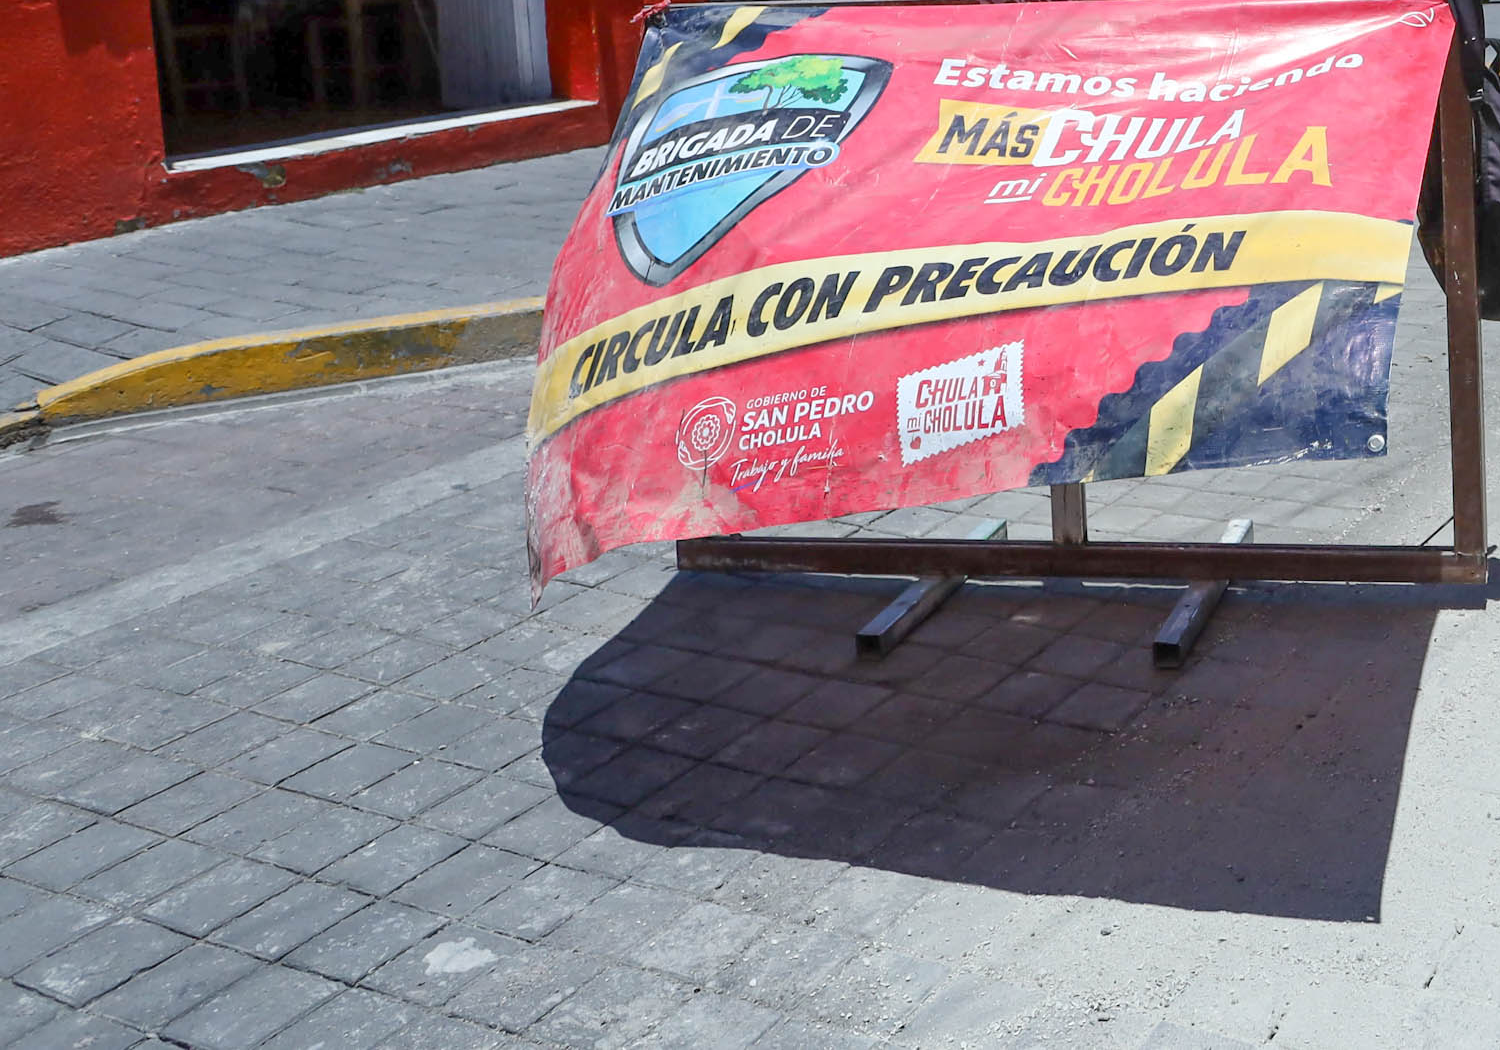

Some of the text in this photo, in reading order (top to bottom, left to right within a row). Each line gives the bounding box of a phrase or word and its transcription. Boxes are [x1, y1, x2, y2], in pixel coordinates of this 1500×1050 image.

[933, 53, 1364, 103] Estamos haciendo
[630, 113, 841, 179] BRIGADA DE
[936, 107, 1246, 167] MÁS CHULA
[606, 145, 834, 214] MANTENIMIENTO
[984, 126, 1332, 207] mi CHOLULA
[568, 225, 1247, 397] CIRCULA CON PRECAUCIÓN
[741, 390, 874, 432] SAN PEDRO
[746, 386, 827, 410] GOBIERNO DE
[915, 376, 978, 410] CHULA
[923, 395, 1007, 434] CHOLULA
[738, 422, 822, 451] CHOLULA
[729, 458, 778, 492] Trabajo
